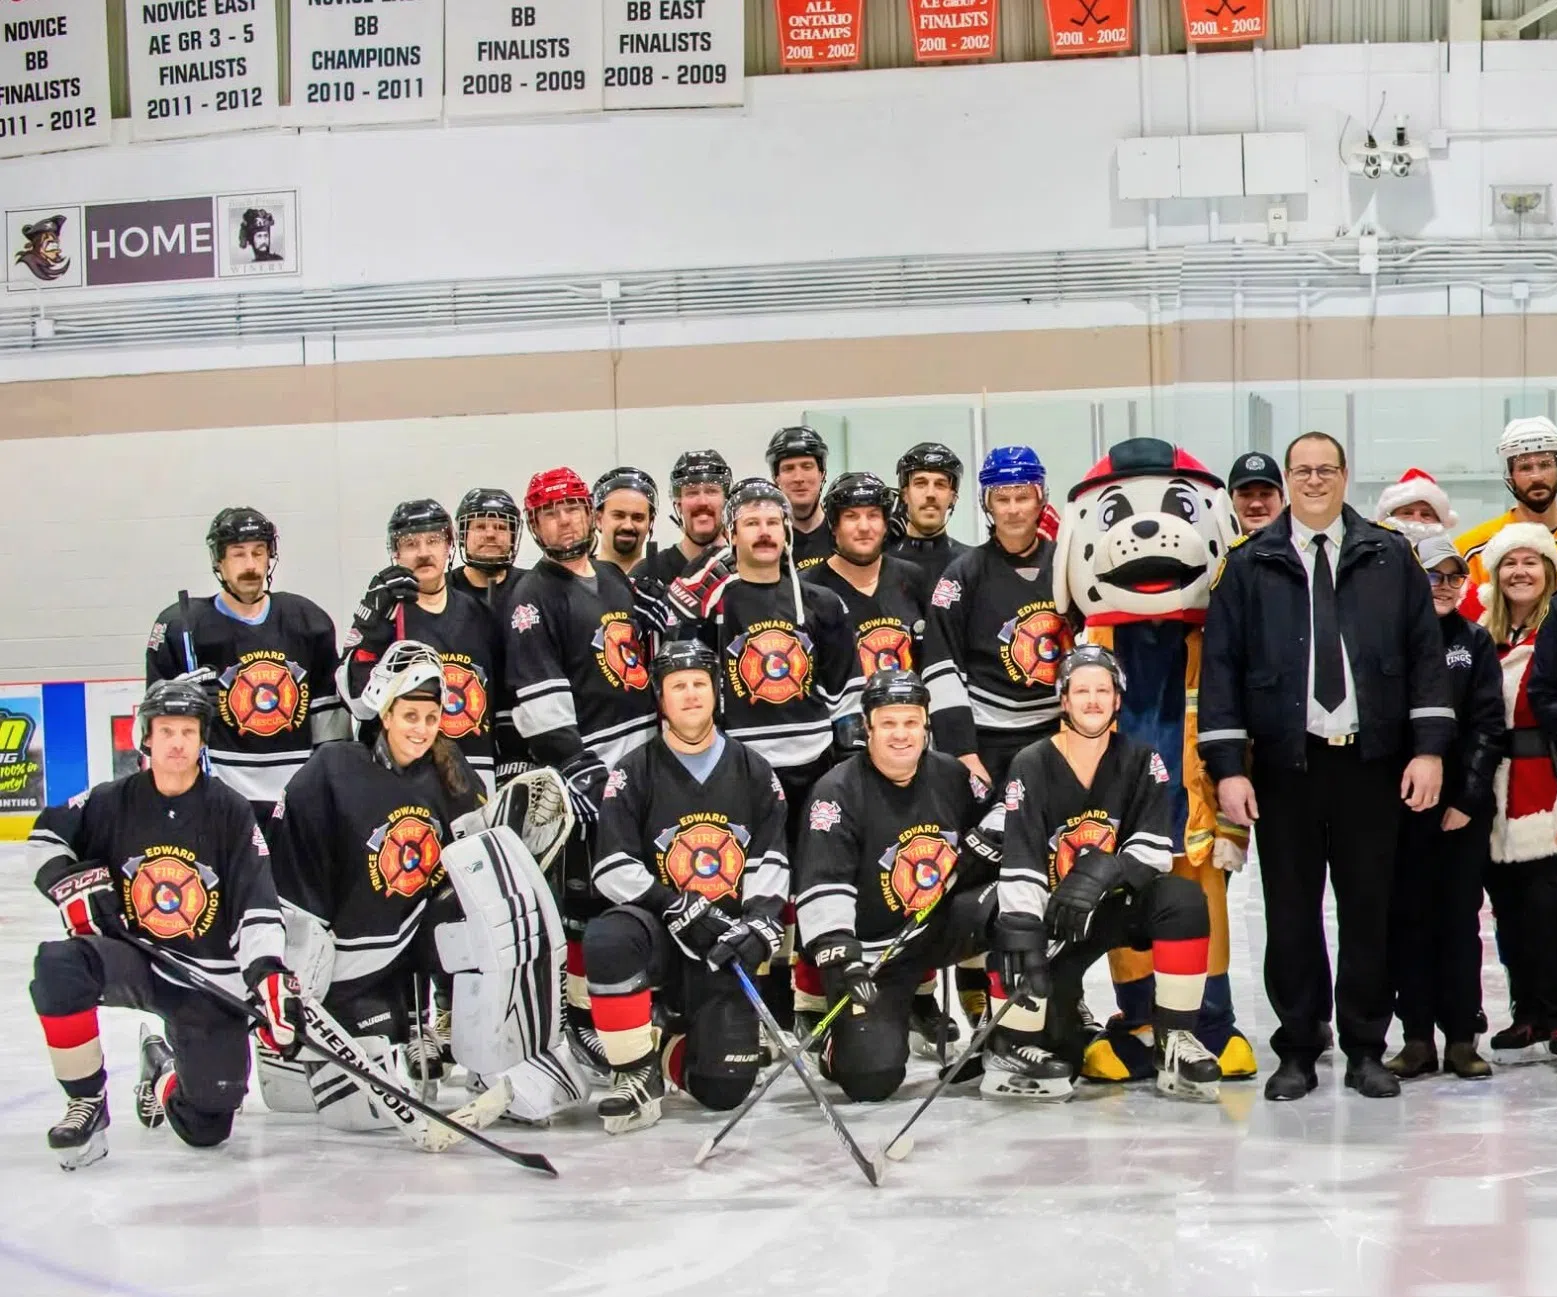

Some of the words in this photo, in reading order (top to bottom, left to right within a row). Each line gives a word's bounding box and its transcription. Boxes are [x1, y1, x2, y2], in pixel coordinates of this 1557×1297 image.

[142, 0, 208, 24] NOVICE
[511, 7, 536, 28] BB
[626, 0, 652, 22] BB
[659, 0, 704, 20] EAST
[806, 1, 836, 14] ALL
[4, 16, 68, 42] NOVICE
[354, 15, 379, 36] BB
[788, 14, 853, 28] ONTARIO
[919, 11, 989, 30] FINALISTS
[1190, 21, 1219, 36] 2001
[1232, 17, 1262, 34] 2002
[149, 34, 171, 56] AE
[179, 30, 202, 52] GR
[210, 28, 221, 48] 3
[243, 23, 254, 44] 5
[619, 32, 712, 54] FINALISTS
[790, 26, 852, 41] CHAMPS
[919, 37, 948, 53] 2001
[960, 34, 990, 50] 2002
[1055, 30, 1086, 46] 2001
[1097, 27, 1127, 44] 2002
[311, 46, 422, 71] CHAMPIONS
[477, 37, 571, 62] FINALISTS
[786, 44, 814, 60] 2001
[827, 43, 856, 58] 2002
[25, 50, 49, 71] BB
[159, 57, 248, 86] FINALISTS
[604, 67, 653, 88] 2008
[677, 64, 727, 85] 2009
[307, 80, 355, 103] 2010
[378, 77, 424, 100] 2011
[462, 73, 512, 95] 2008
[535, 70, 586, 92] 2009
[147, 95, 193, 120] 2011
[216, 87, 263, 112] 2012
[50, 106, 97, 131] 2012
[91, 222, 212, 260] HOME
[1017, 600, 1056, 618] EDWAR
[747, 619, 793, 634] EDWARD
[859, 617, 902, 632] EDWARD
[759, 638, 788, 650] FIRE
[869, 635, 897, 648] FIRE
[240, 651, 286, 665] EDWARD
[441, 653, 472, 665] WARD
[1000, 645, 1021, 682] PRINCE
[251, 670, 278, 681] FIRE
[595, 652, 619, 687] PRINCE
[728, 658, 746, 698] PRINCE
[295, 682, 308, 728] COUNTY
[0, 798, 37, 807] NTING
[388, 805, 431, 824] EDWARD
[678, 812, 729, 827] EDWARD
[1066, 809, 1108, 828] EDWARD
[398, 826, 424, 839] FIRE
[688, 833, 721, 845] FIRE
[899, 824, 940, 844] EDWARD
[1074, 830, 1101, 843] FIRE
[145, 846, 197, 863] EDWARD
[908, 843, 935, 858] FIRE
[965, 833, 1002, 863] BAU
[153, 866, 186, 880] FIRE
[368, 853, 384, 892] PRINCE
[656, 852, 670, 886] RINCE
[53, 866, 112, 900] CCM
[880, 872, 899, 912] PRINCE
[122, 878, 135, 921] PRINCE
[197, 889, 220, 936] COUNTY
